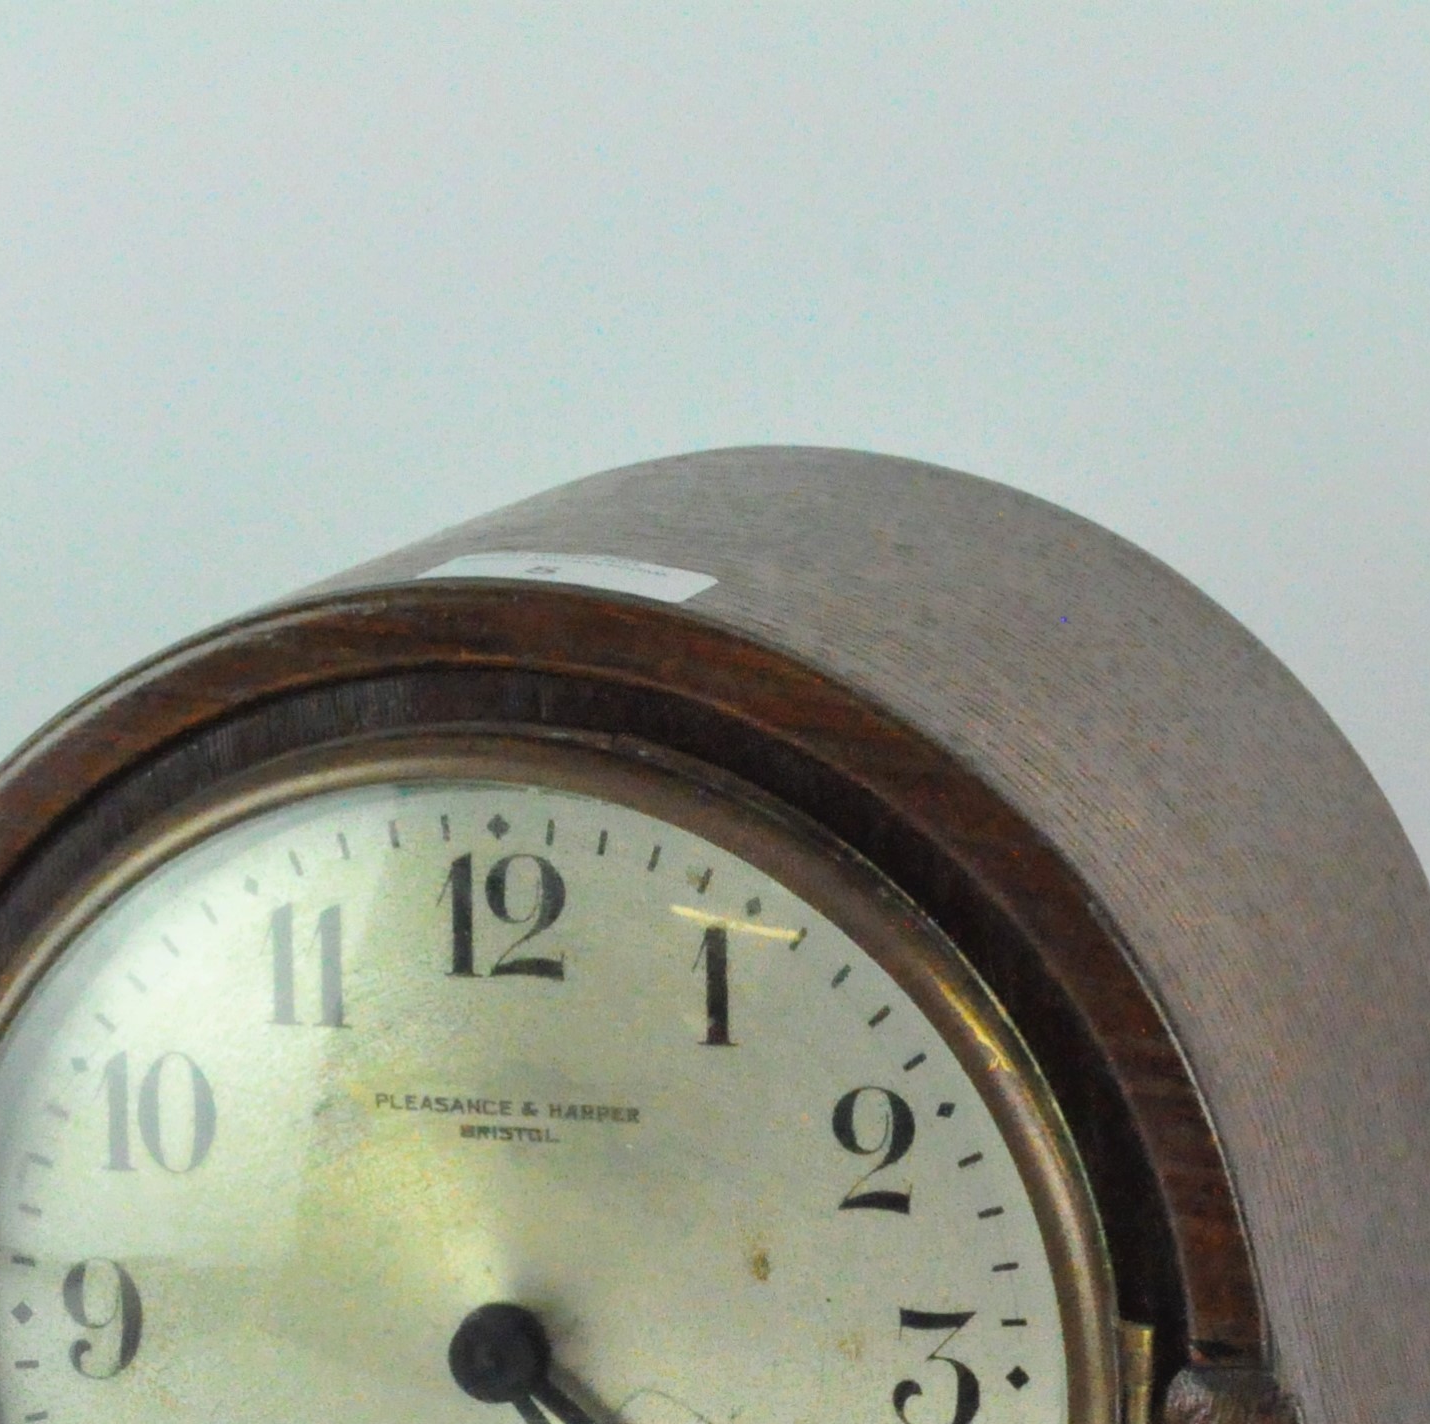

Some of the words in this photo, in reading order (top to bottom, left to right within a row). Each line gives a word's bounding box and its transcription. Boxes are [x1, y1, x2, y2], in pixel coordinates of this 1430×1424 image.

[264, 902, 352, 1029] 11
[436, 851, 566, 981] 12
[692, 926, 740, 1046] 1
[95, 1049, 217, 1174] 10
[375, 1093, 512, 1116] PLEASANCE
[521, 1101, 539, 1117] &
[548, 1103, 641, 1123] HARPER
[832, 1086, 916, 1215] 2
[62, 1257, 143, 1380] 9
